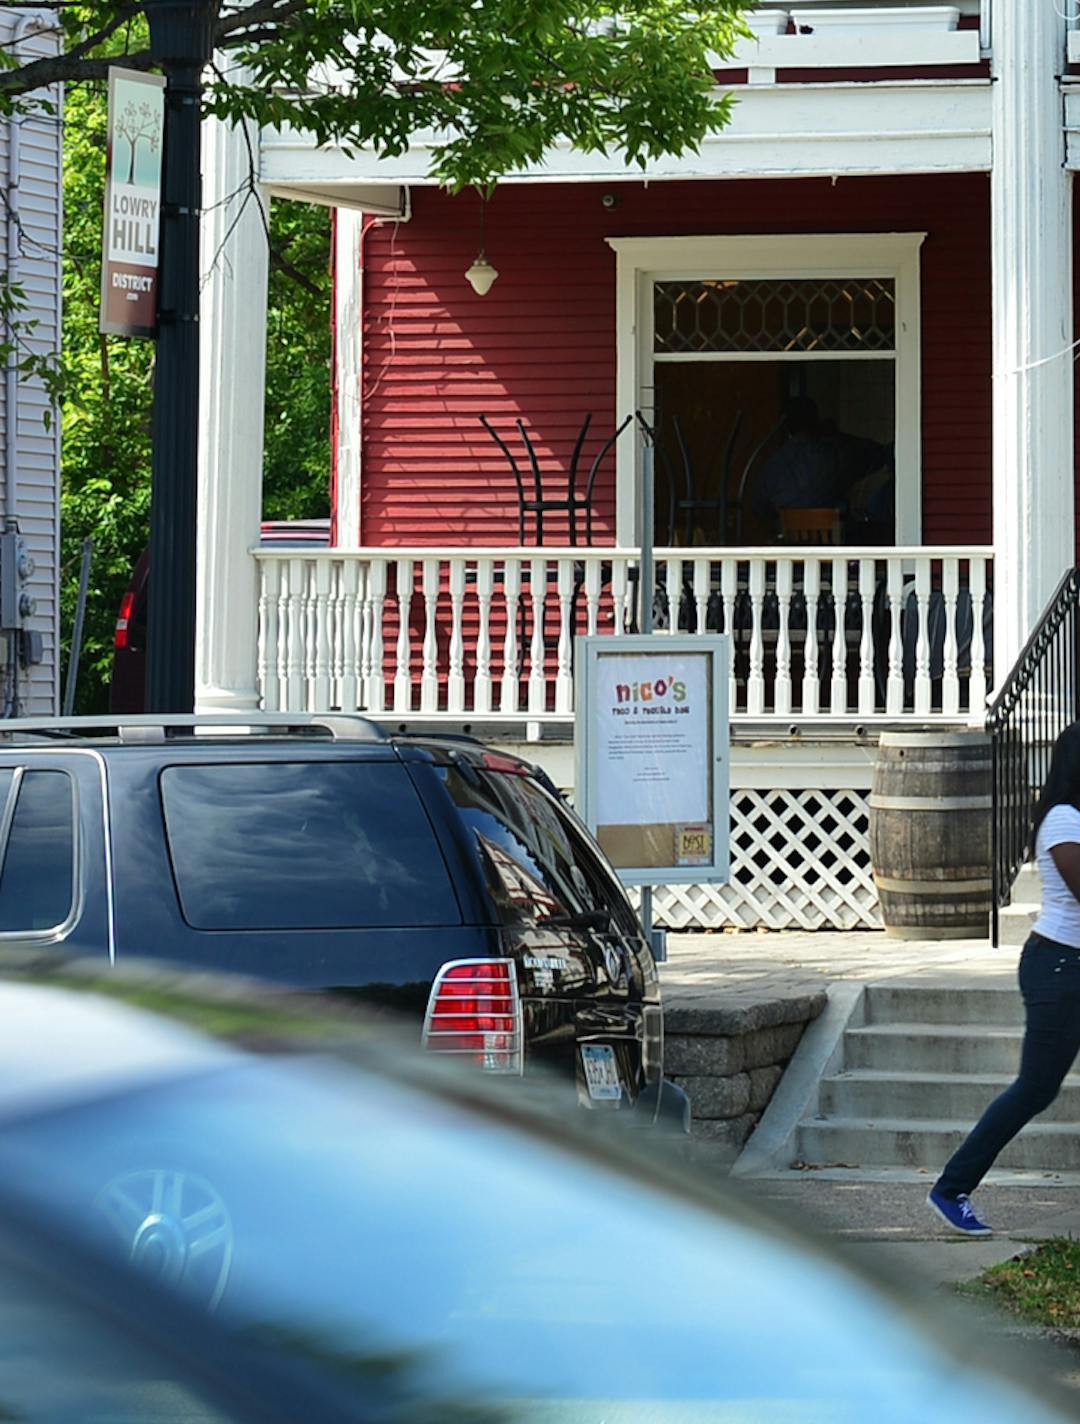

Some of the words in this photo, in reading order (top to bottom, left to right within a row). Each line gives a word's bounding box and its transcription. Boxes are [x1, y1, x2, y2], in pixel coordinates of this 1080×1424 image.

[113, 193, 157, 219] LOWRY
[113, 219, 155, 255] HILL
[113, 272, 152, 291] DISTRICT
[616, 676, 686, 703] nico's
